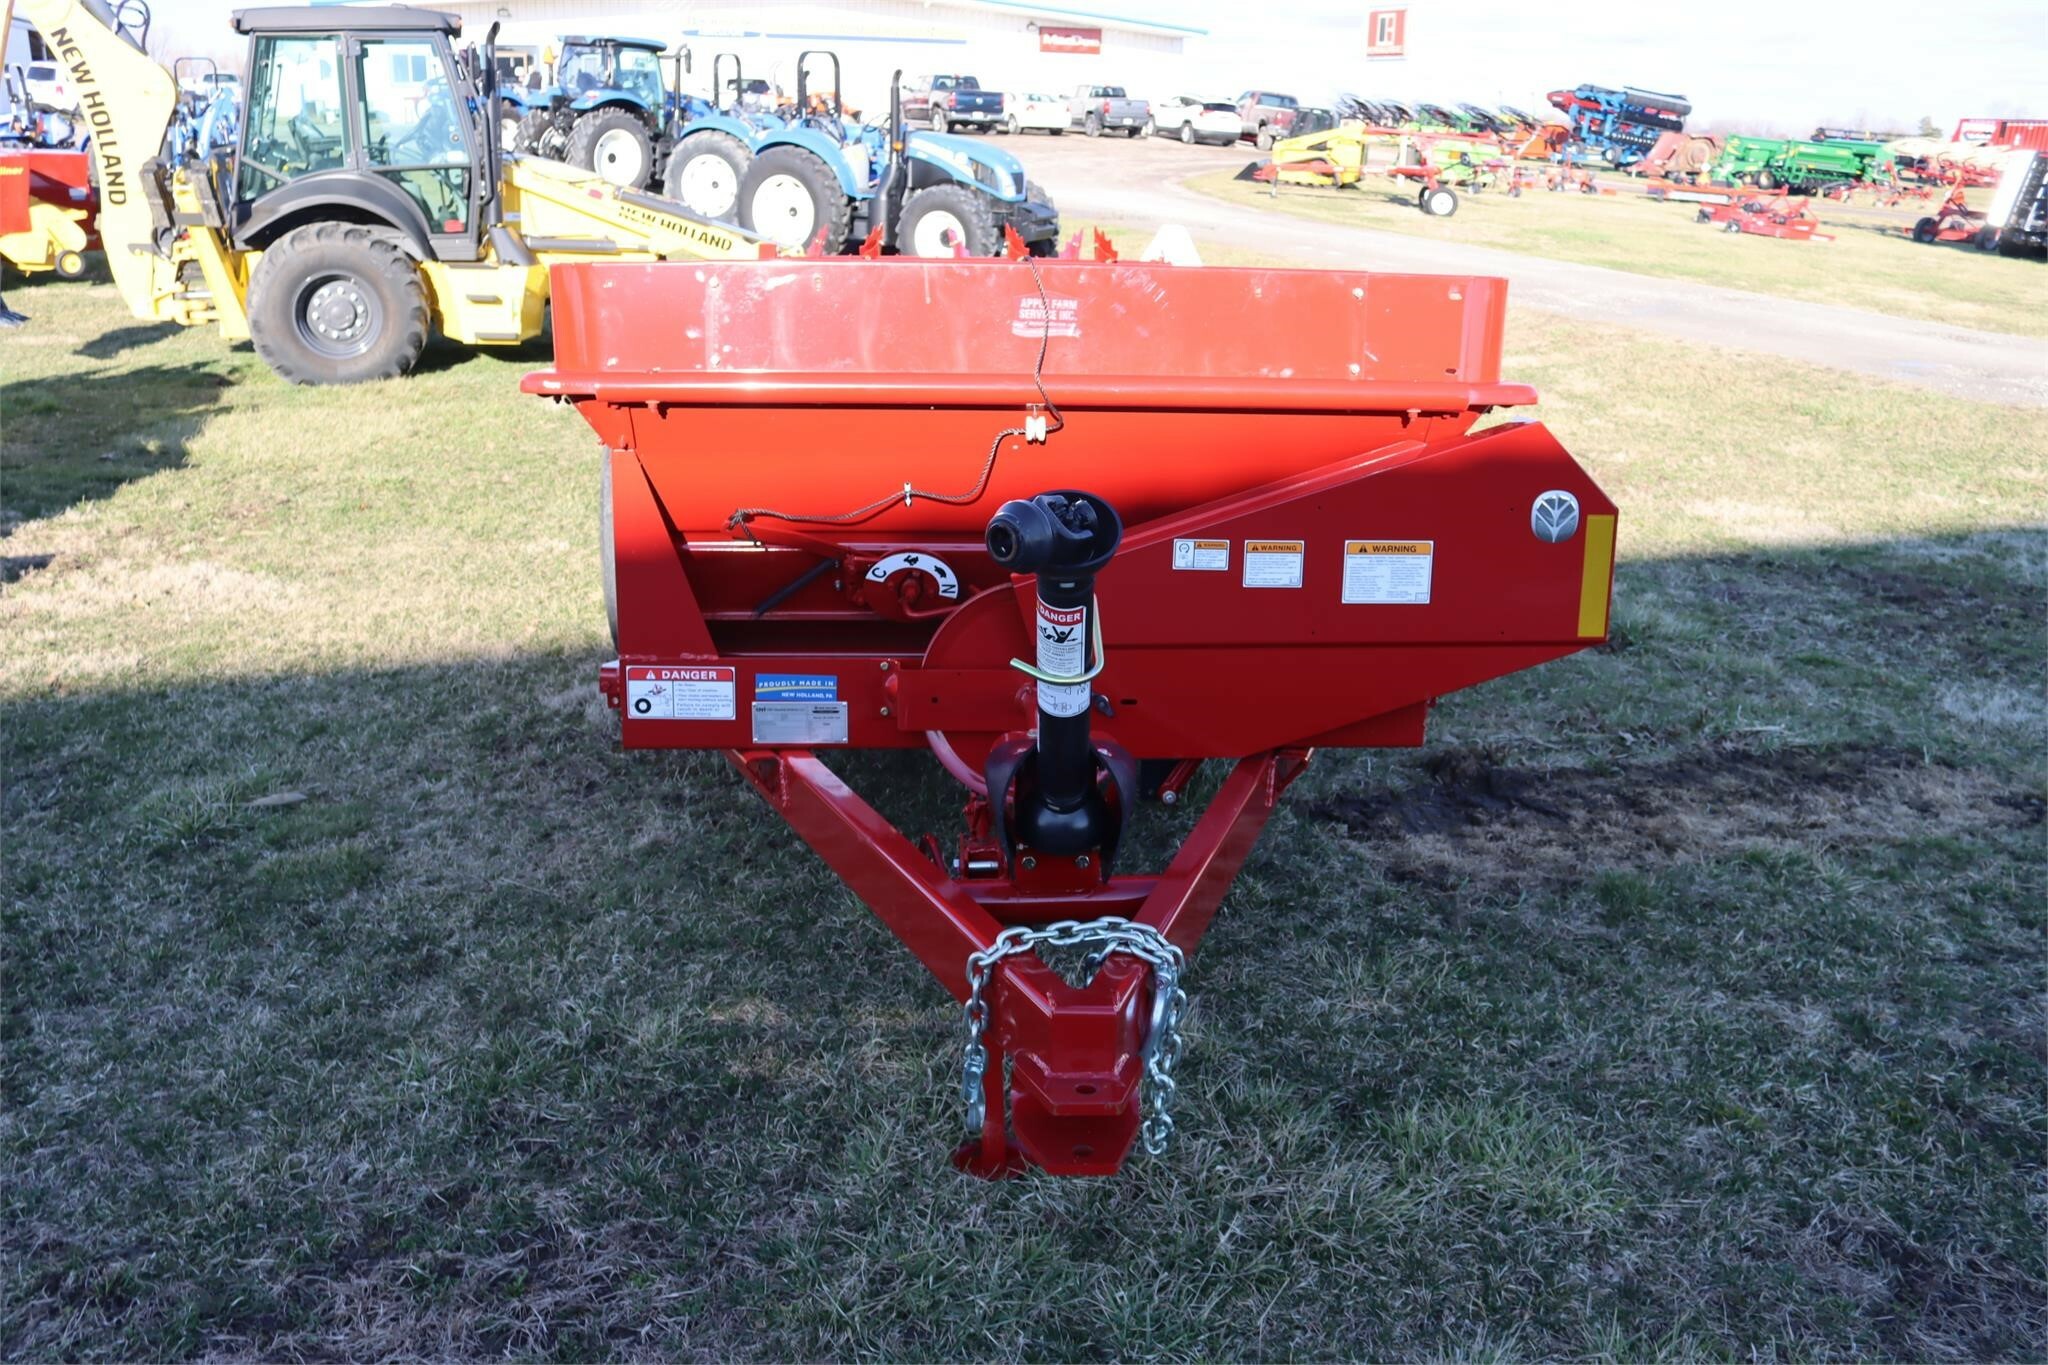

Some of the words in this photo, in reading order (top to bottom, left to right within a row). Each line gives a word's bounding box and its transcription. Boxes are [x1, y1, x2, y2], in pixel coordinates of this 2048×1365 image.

[51, 27, 96, 84] NEW
[83, 91, 127, 206] HOLLAND
[660, 219, 732, 251] HOLLAND
[1260, 544, 1297, 552] WARNING
[1372, 545, 1417, 553] WARNING
[1039, 604, 1081, 623] DANGER
[661, 671, 717, 680] DANGER
